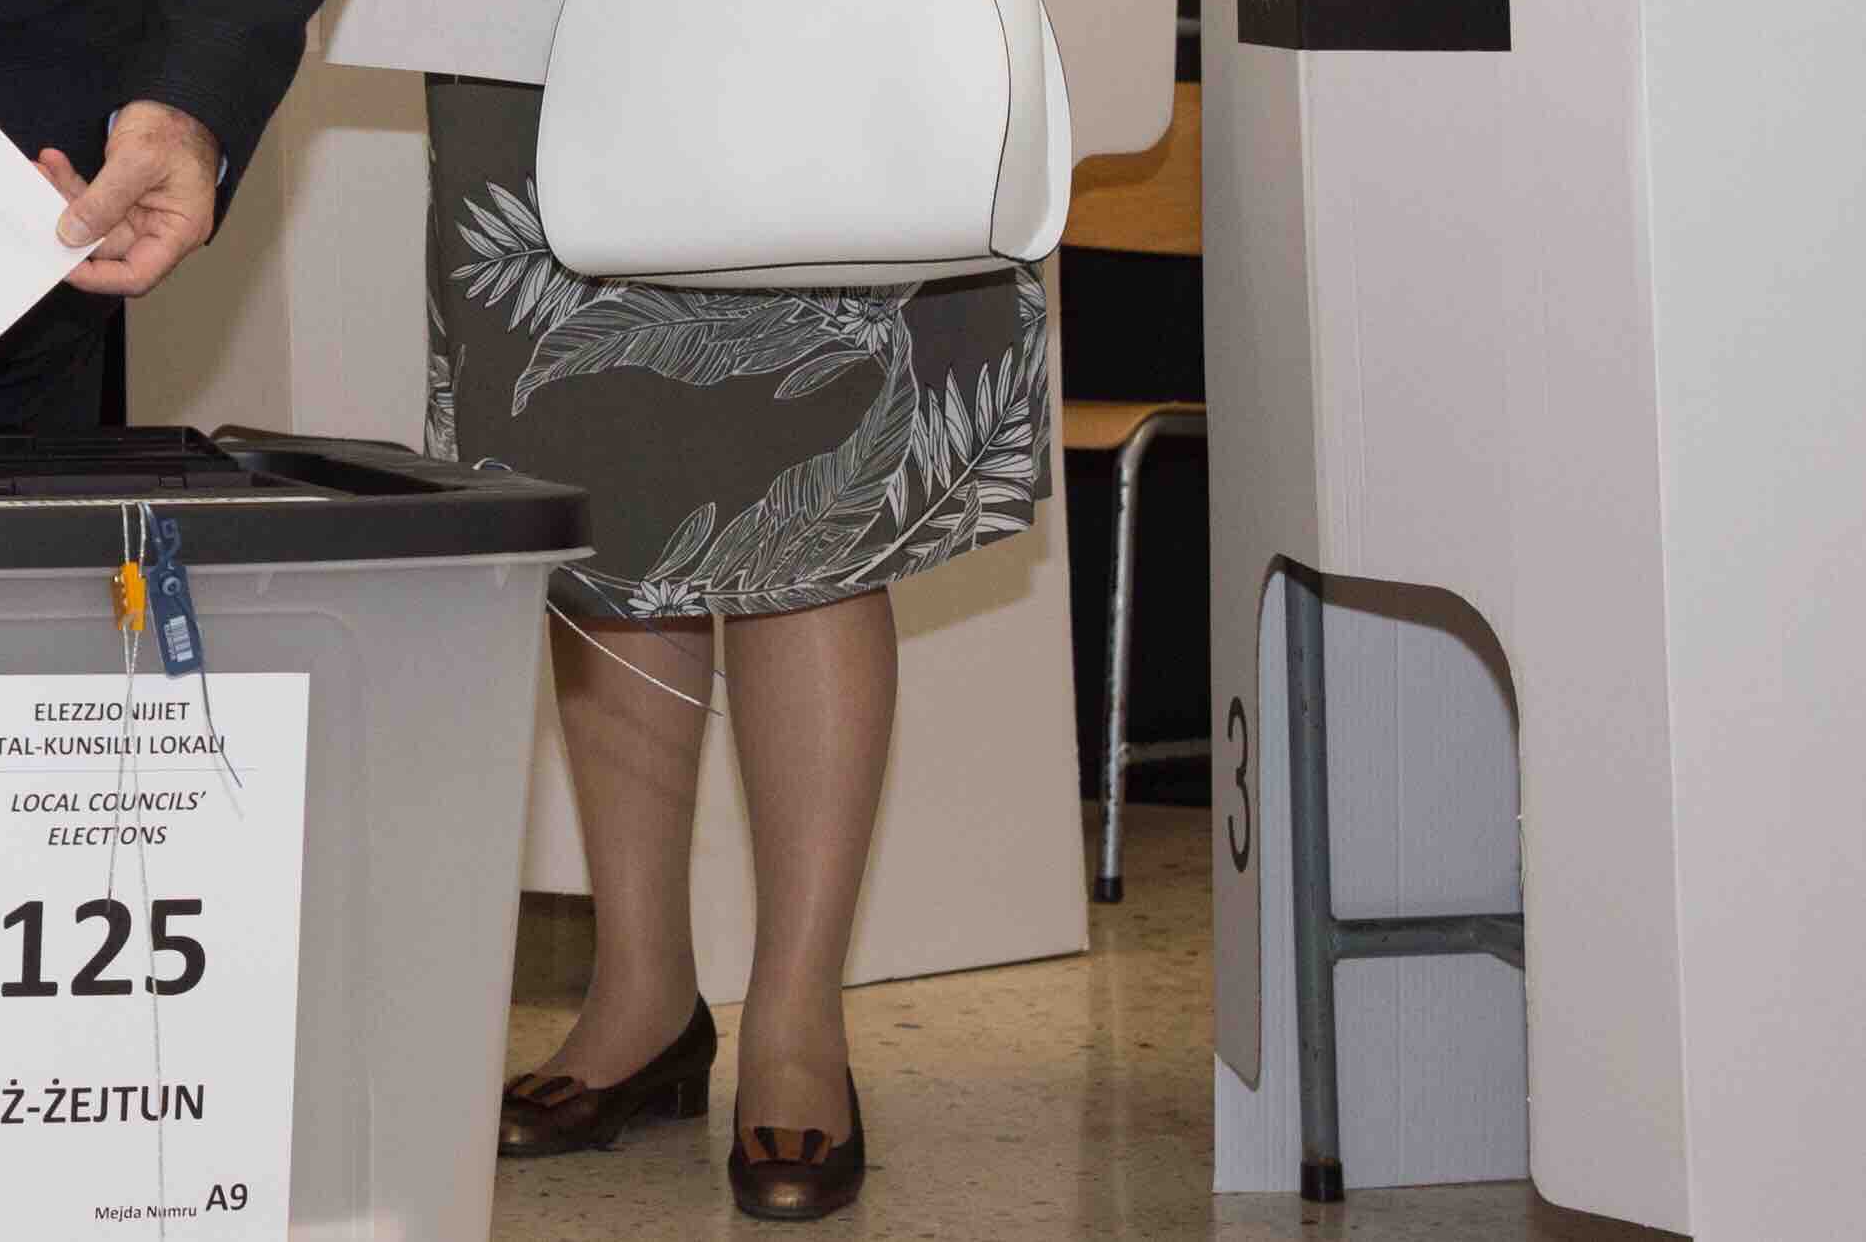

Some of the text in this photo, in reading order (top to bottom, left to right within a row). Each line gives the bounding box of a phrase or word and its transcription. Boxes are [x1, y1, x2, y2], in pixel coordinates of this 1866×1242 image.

[35, 702, 190, 721] ELEZZJONIJIET
[150, 735, 225, 755] LOKALI
[1228, 696, 1251, 873] 3
[11, 793, 80, 813] LOCAL
[1, 899, 206, 997] 125
[95, 1183, 248, 1223] Mejda Numru A9
